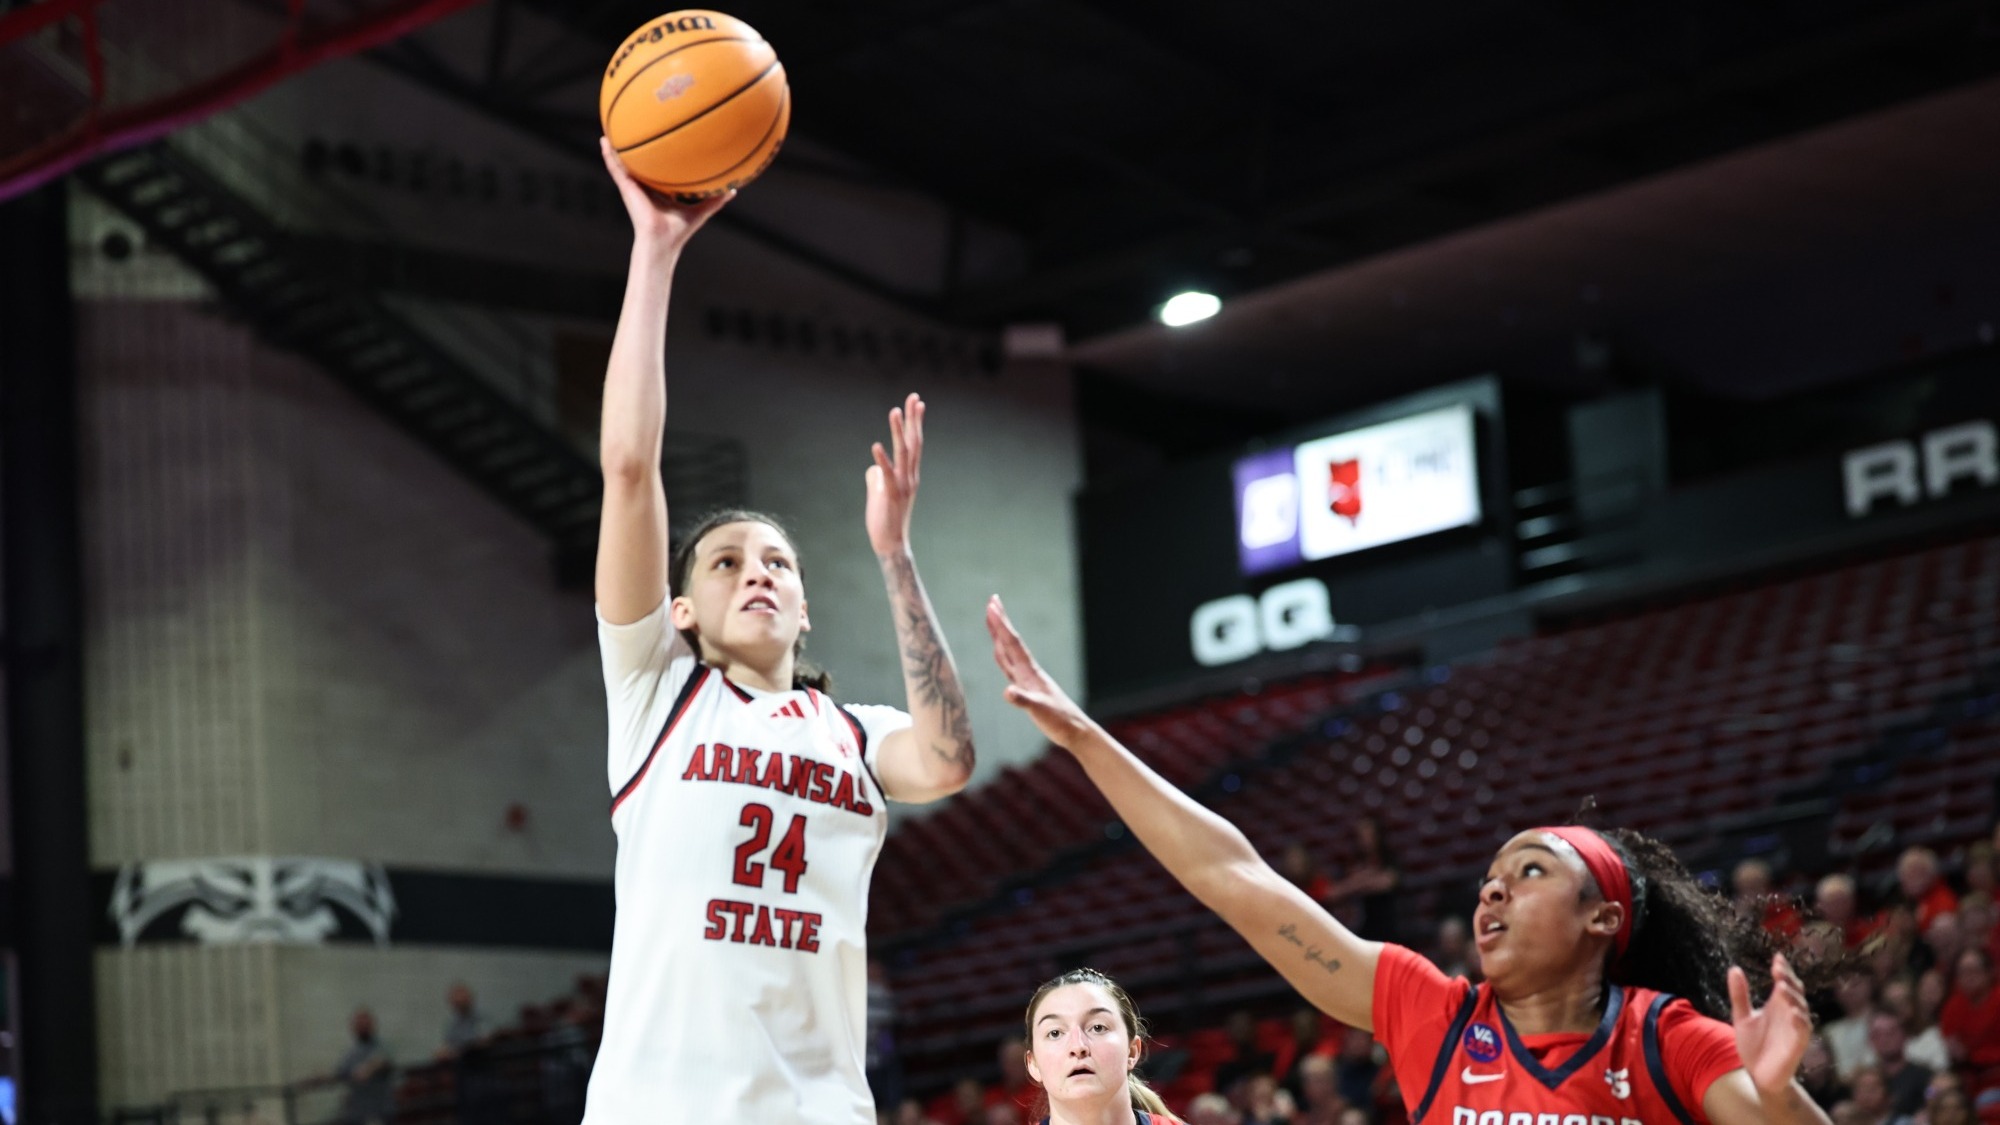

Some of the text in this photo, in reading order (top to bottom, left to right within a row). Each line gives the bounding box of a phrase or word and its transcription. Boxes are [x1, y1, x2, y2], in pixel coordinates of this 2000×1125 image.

[1843, 420, 1998, 517] RR
[732, 802, 808, 894] 24
[704, 899, 822, 954] STATE
[1474, 1024, 1494, 1045] VA
